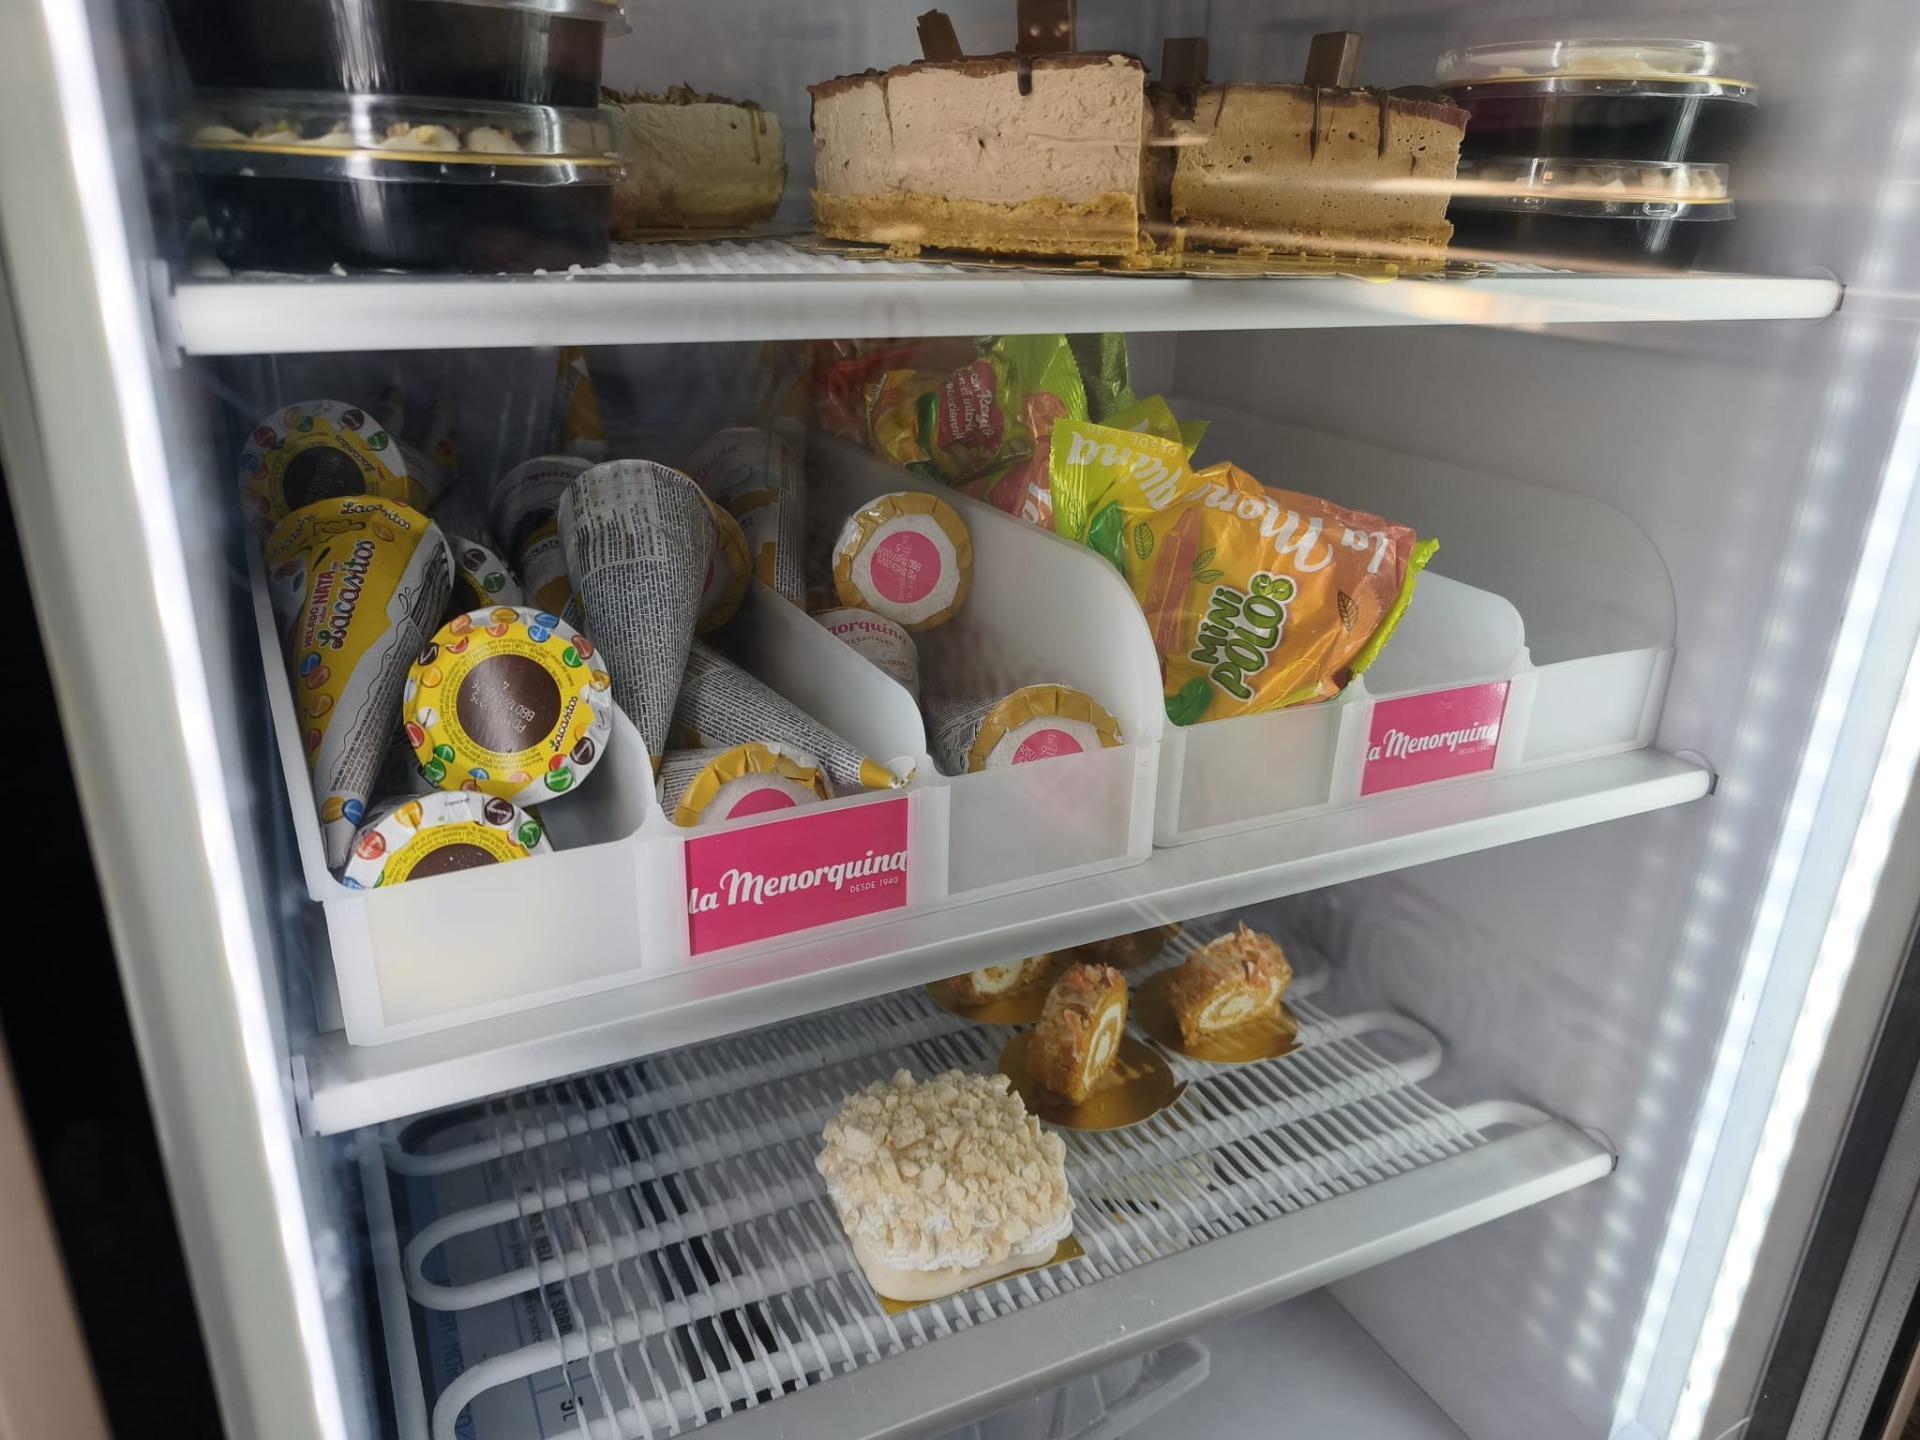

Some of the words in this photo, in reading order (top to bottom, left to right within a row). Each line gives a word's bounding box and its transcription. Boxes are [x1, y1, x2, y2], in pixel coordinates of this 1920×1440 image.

[313, 570, 336, 605] NATA
[316, 539, 377, 649] Lacasitos
[304, 607, 319, 648] HELADO
[1209, 573, 1296, 699] POLOS
[549, 695, 579, 752] Lacasitos
[688, 887, 719, 914] la
[719, 850, 908, 904] Menorquina
[849, 880, 877, 894] DESDE
[879, 876, 900, 889] 1940
